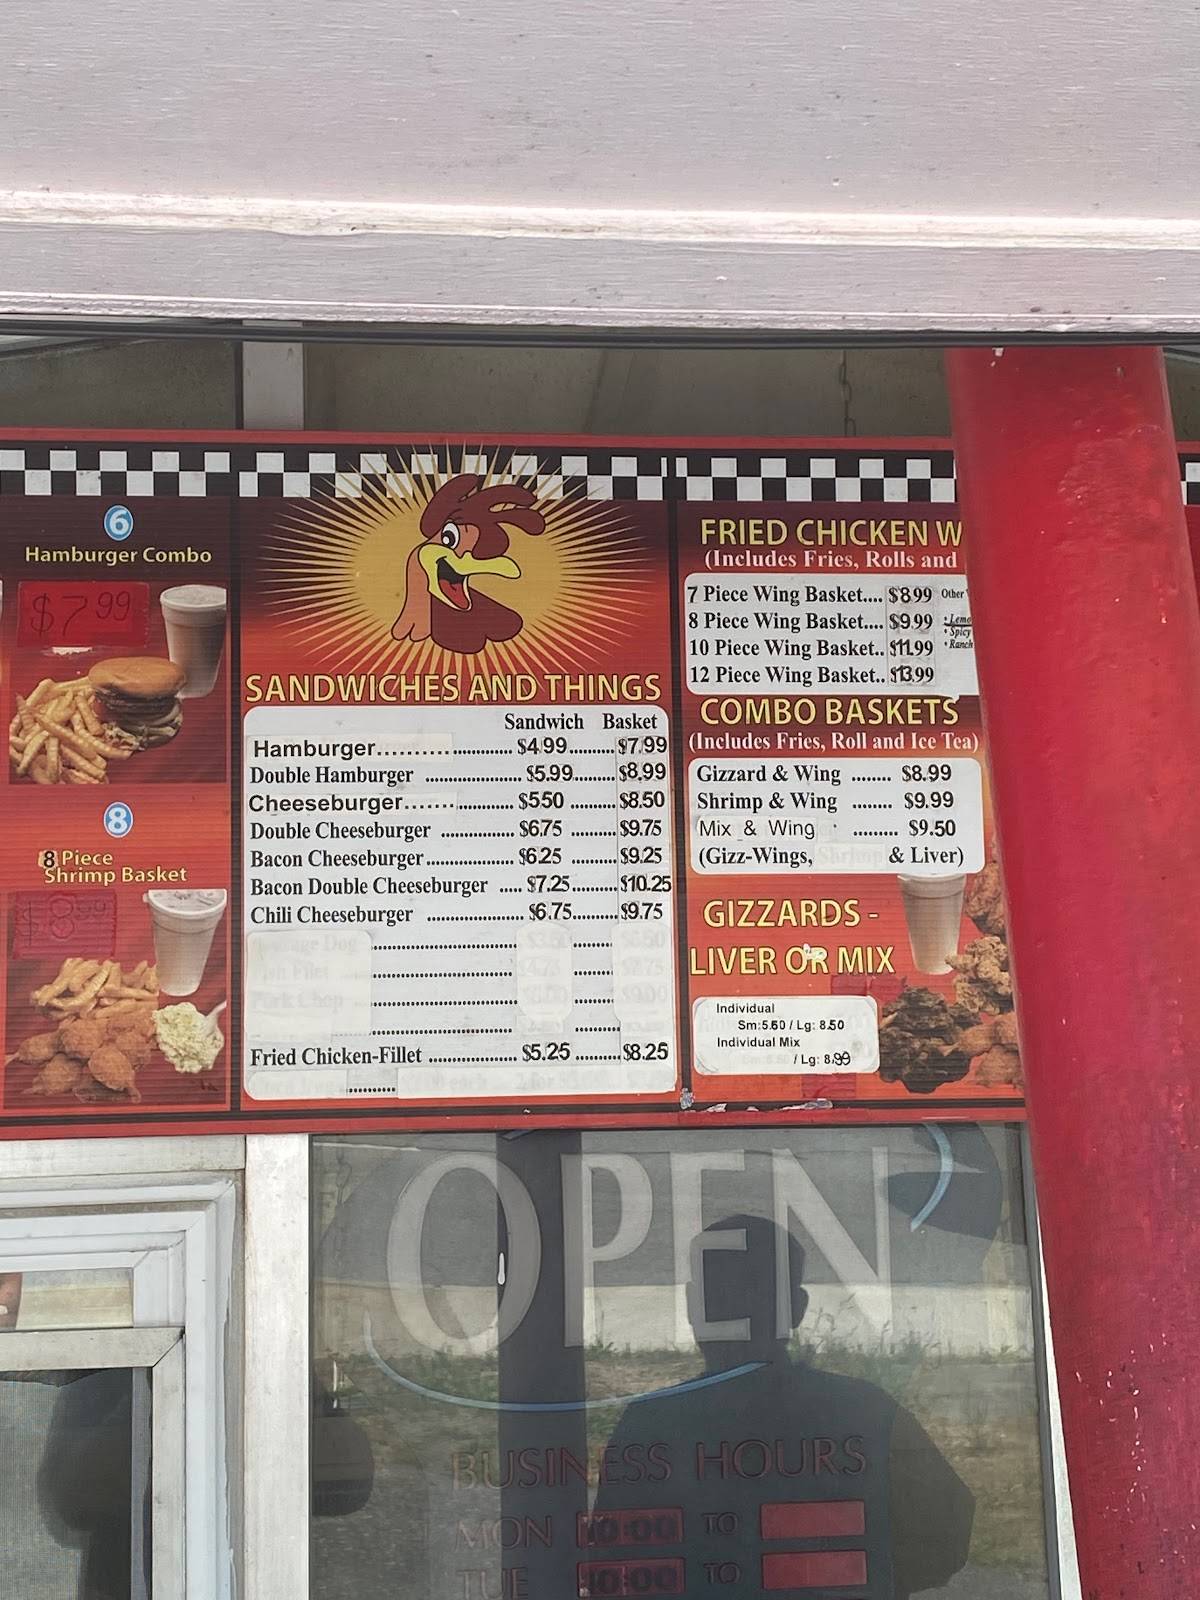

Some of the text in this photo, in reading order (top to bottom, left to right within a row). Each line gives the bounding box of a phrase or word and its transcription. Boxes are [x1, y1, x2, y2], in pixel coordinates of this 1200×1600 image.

[109, 508, 130, 532] 6
[700, 518, 788, 546] FRIED
[796, 519, 928, 547] CHICKEN
[25, 546, 213, 567] Hamburger Combo
[705, 549, 958, 571] (Includes Fries, Rolls and
[687, 586, 698, 604] 7
[703, 584, 749, 603] Piece
[753, 585, 800, 607] Wing
[941, 588, 965, 599] Other
[688, 611, 698, 629] 8
[704, 611, 749, 630] Piece
[754, 611, 801, 634] Wing
[889, 612, 934, 630] $9.99
[689, 639, 709, 656] 10
[714, 638, 760, 657] Piece
[763, 639, 811, 661] Wing
[889, 638, 934, 658] $11.99
[245, 673, 662, 703] SANDWICHES AND THINGS
[690, 666, 710, 683] 12
[715, 665, 761, 684] Piece
[764, 666, 812, 688] Wing
[890, 665, 935, 684] $13.99
[504, 712, 658, 731] Sandwich Basket
[700, 696, 960, 726] COMBO BASKETS
[617, 735, 668, 756] $7.99
[688, 731, 980, 753] (Includes Fries, Roll and Ice Tea)
[249, 766, 311, 784] Double
[315, 765, 415, 788] Hamburger
[618, 761, 667, 782] $8.99
[696, 763, 953, 786] Gizzard & Wing $8.99
[619, 790, 666, 810] $8.50
[696, 790, 955, 813] Shrimp & Wing $9.99
[110, 809, 126, 832] 8
[250, 819, 662, 843] Double Cheeseburger $6.75 $9.75
[699, 818, 957, 840] Mix & Wing $9.50
[43, 849, 114, 868] 8 Piece
[250, 850, 303, 868] Bacon
[620, 846, 663, 866] $9.25
[698, 846, 814, 868] (Gizz-Wings,
[888, 846, 905, 864] &
[910, 845, 965, 867] Liver)
[44, 866, 188, 886] Shrimp Basket
[250, 878, 303, 896] Bacon
[308, 877, 368, 896] Double
[373, 876, 489, 898] Cheeseburger
[620, 874, 672, 893] $10.25
[250, 906, 292, 924] Chili
[296, 905, 414, 927] Cheeseburger
[620, 902, 663, 921] $9.75
[702, 898, 861, 929] GIZZARDS
[689, 945, 777, 976] LIVER
[784, 945, 829, 975] OR
[837, 945, 897, 975] MIX
[716, 1002, 775, 1014] Individual
[250, 1041, 669, 1066] Fried Chicken-Fillet $5.25 $8.25
[717, 1036, 801, 1048] Individual Mix
[386, 1146, 893, 1352] OPEN
[449, 1437, 868, 1491] BUSINESS HOURS
[454, 1514, 554, 1552] MON
[703, 1511, 739, 1535] TO
[459, 1566, 529, 1600] TUE
[703, 1561, 742, 1585] TO
